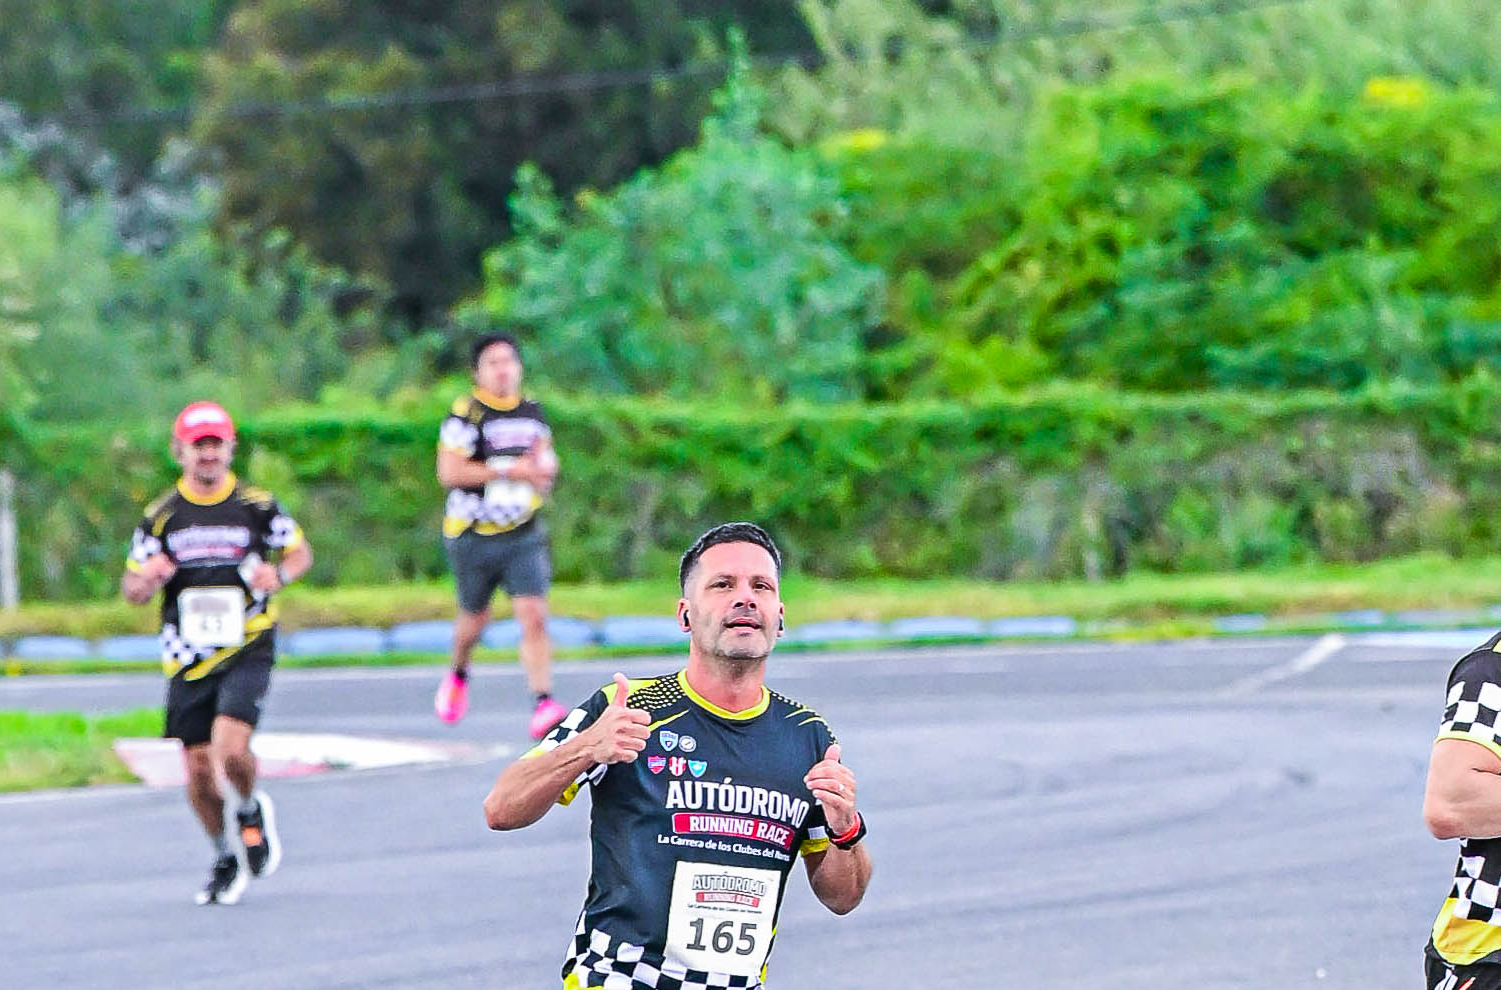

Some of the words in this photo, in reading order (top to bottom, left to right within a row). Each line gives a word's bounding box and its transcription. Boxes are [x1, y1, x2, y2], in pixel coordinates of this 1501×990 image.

[665, 777, 810, 829] AUTÓDROMO
[658, 834, 669, 844] La
[670, 835, 704, 848] Carrera
[705, 839, 717, 850] de
[718, 841, 731, 852] los
[732, 843, 761, 856] Clubes
[689, 816, 755, 836] RUNNING
[756, 822, 790, 846] RACE
[692, 871, 766, 897] AUTÓDROMO
[685, 918, 759, 956] 165
